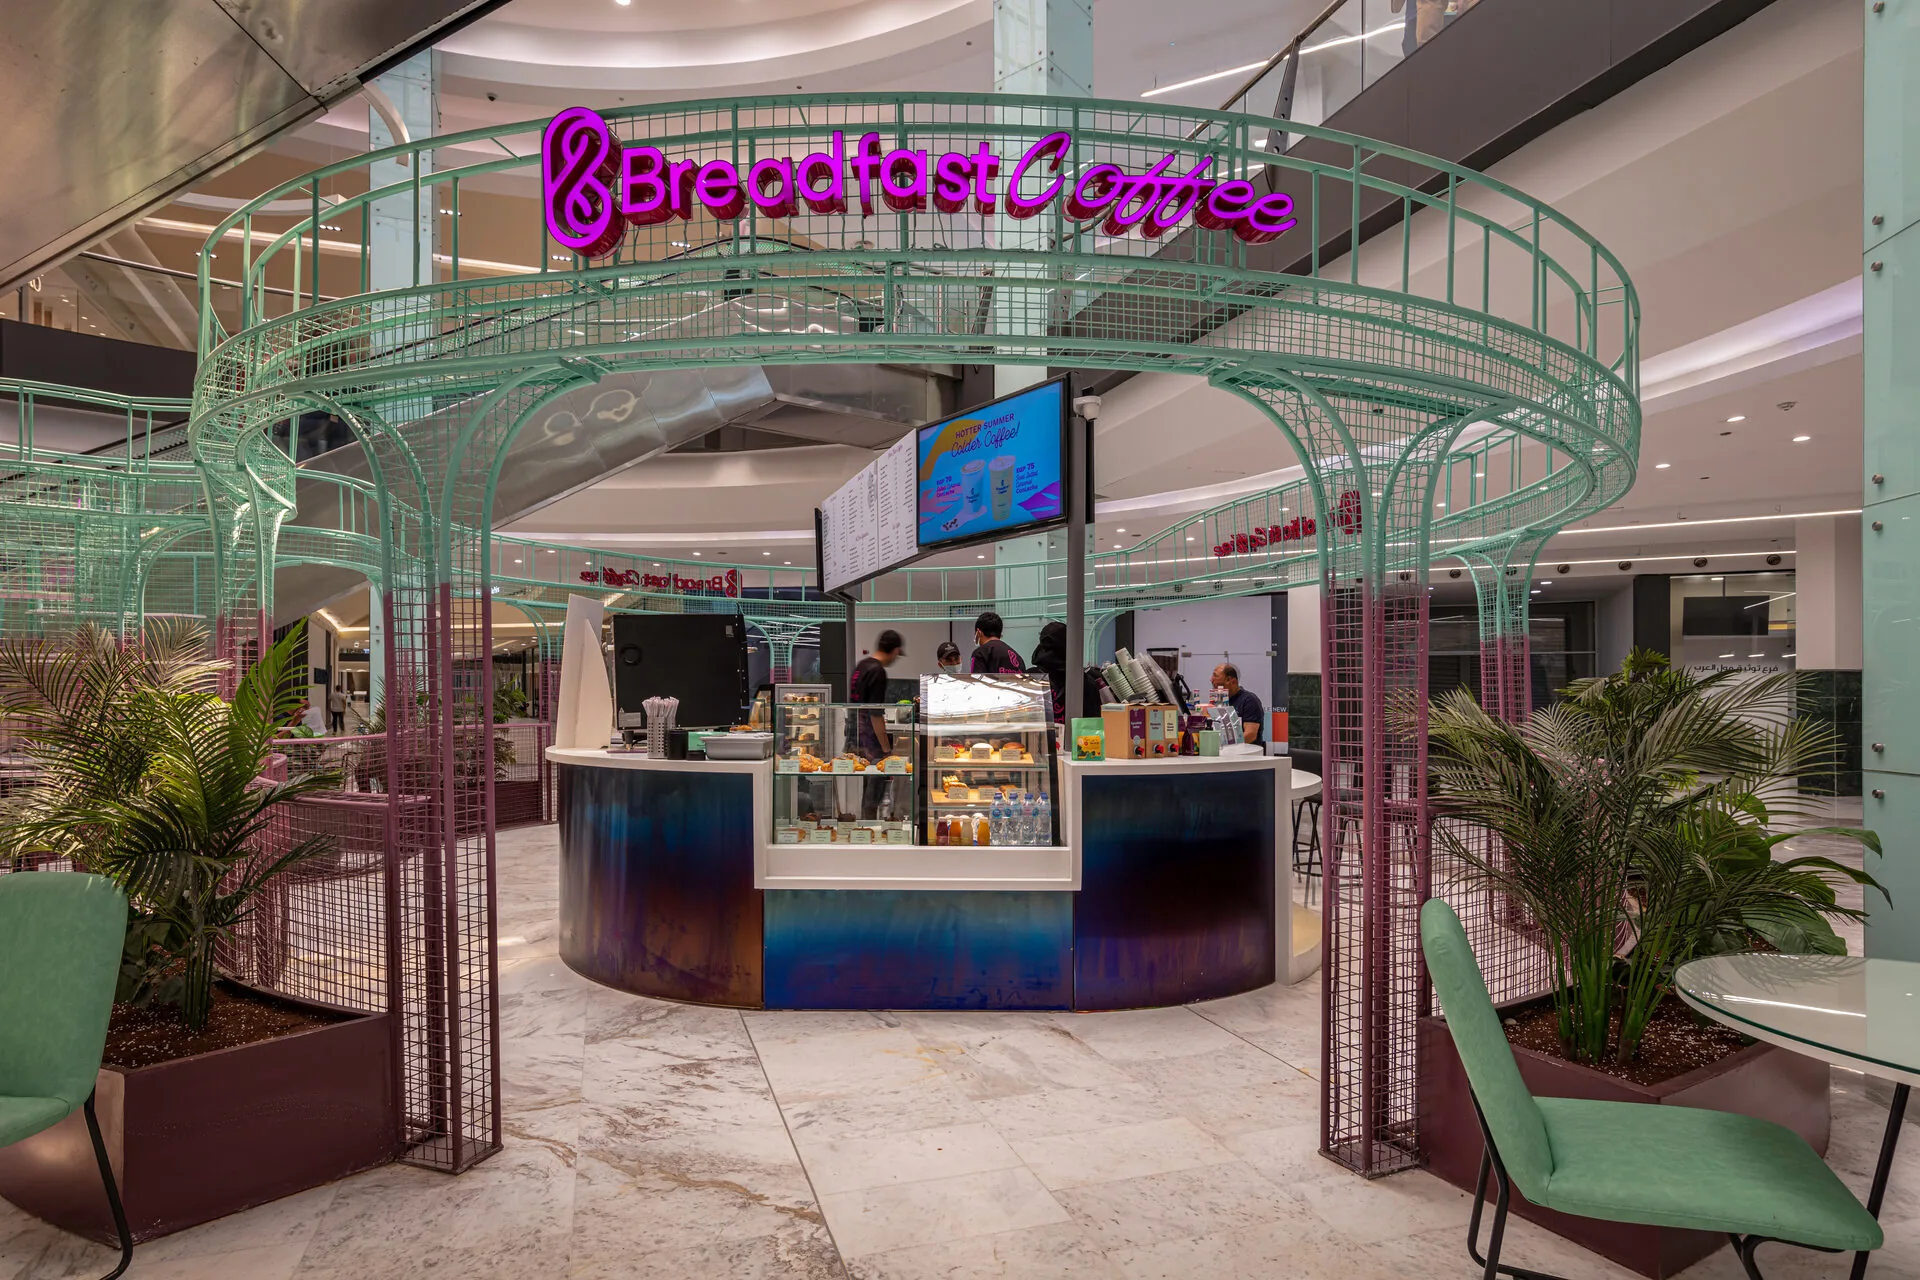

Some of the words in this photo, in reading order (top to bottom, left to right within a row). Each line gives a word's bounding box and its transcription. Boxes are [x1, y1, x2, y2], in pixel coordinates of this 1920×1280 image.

[620, 131, 999, 214] Breadfast
[1009, 131, 1297, 233] Coffee
[955, 424, 982, 439] HOTTER
[983, 413, 1015, 430] SUMMER
[951, 438, 981, 458] Colder
